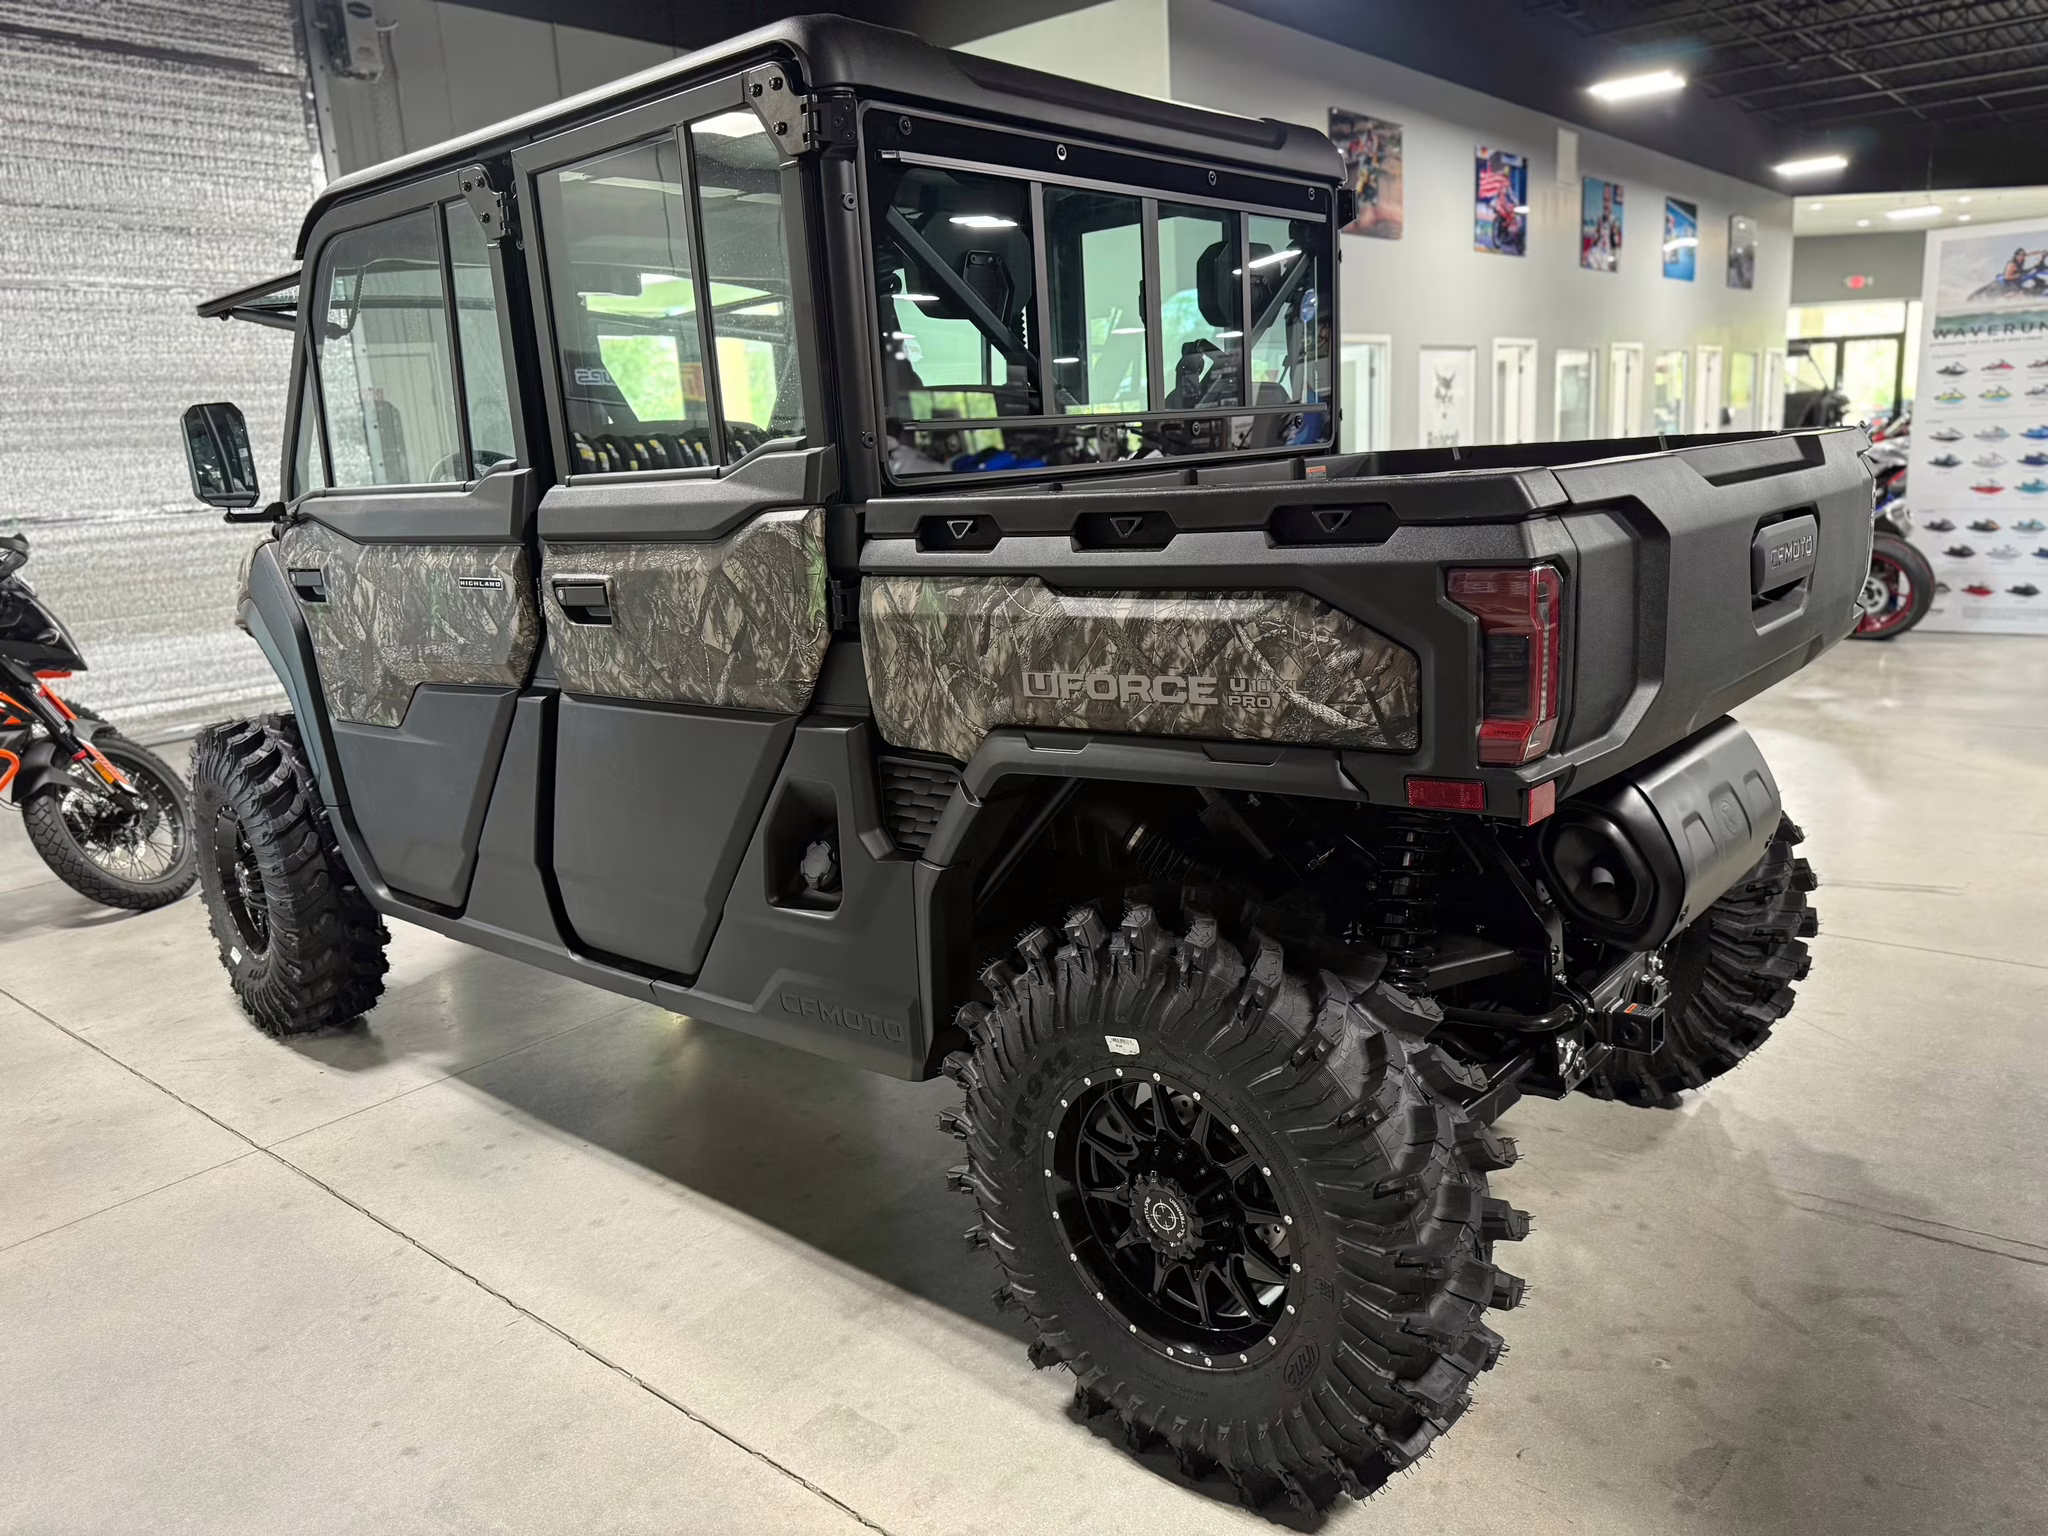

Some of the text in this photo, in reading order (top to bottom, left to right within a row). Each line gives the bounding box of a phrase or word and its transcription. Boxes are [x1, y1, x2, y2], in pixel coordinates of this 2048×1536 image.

[1770, 535, 1813, 569] CFMOTO
[1022, 671, 1219, 705] UFORCE
[1228, 695, 1271, 708] PRO
[1274, 680, 1309, 693] XL
[779, 992, 905, 1043] CFMOTO
